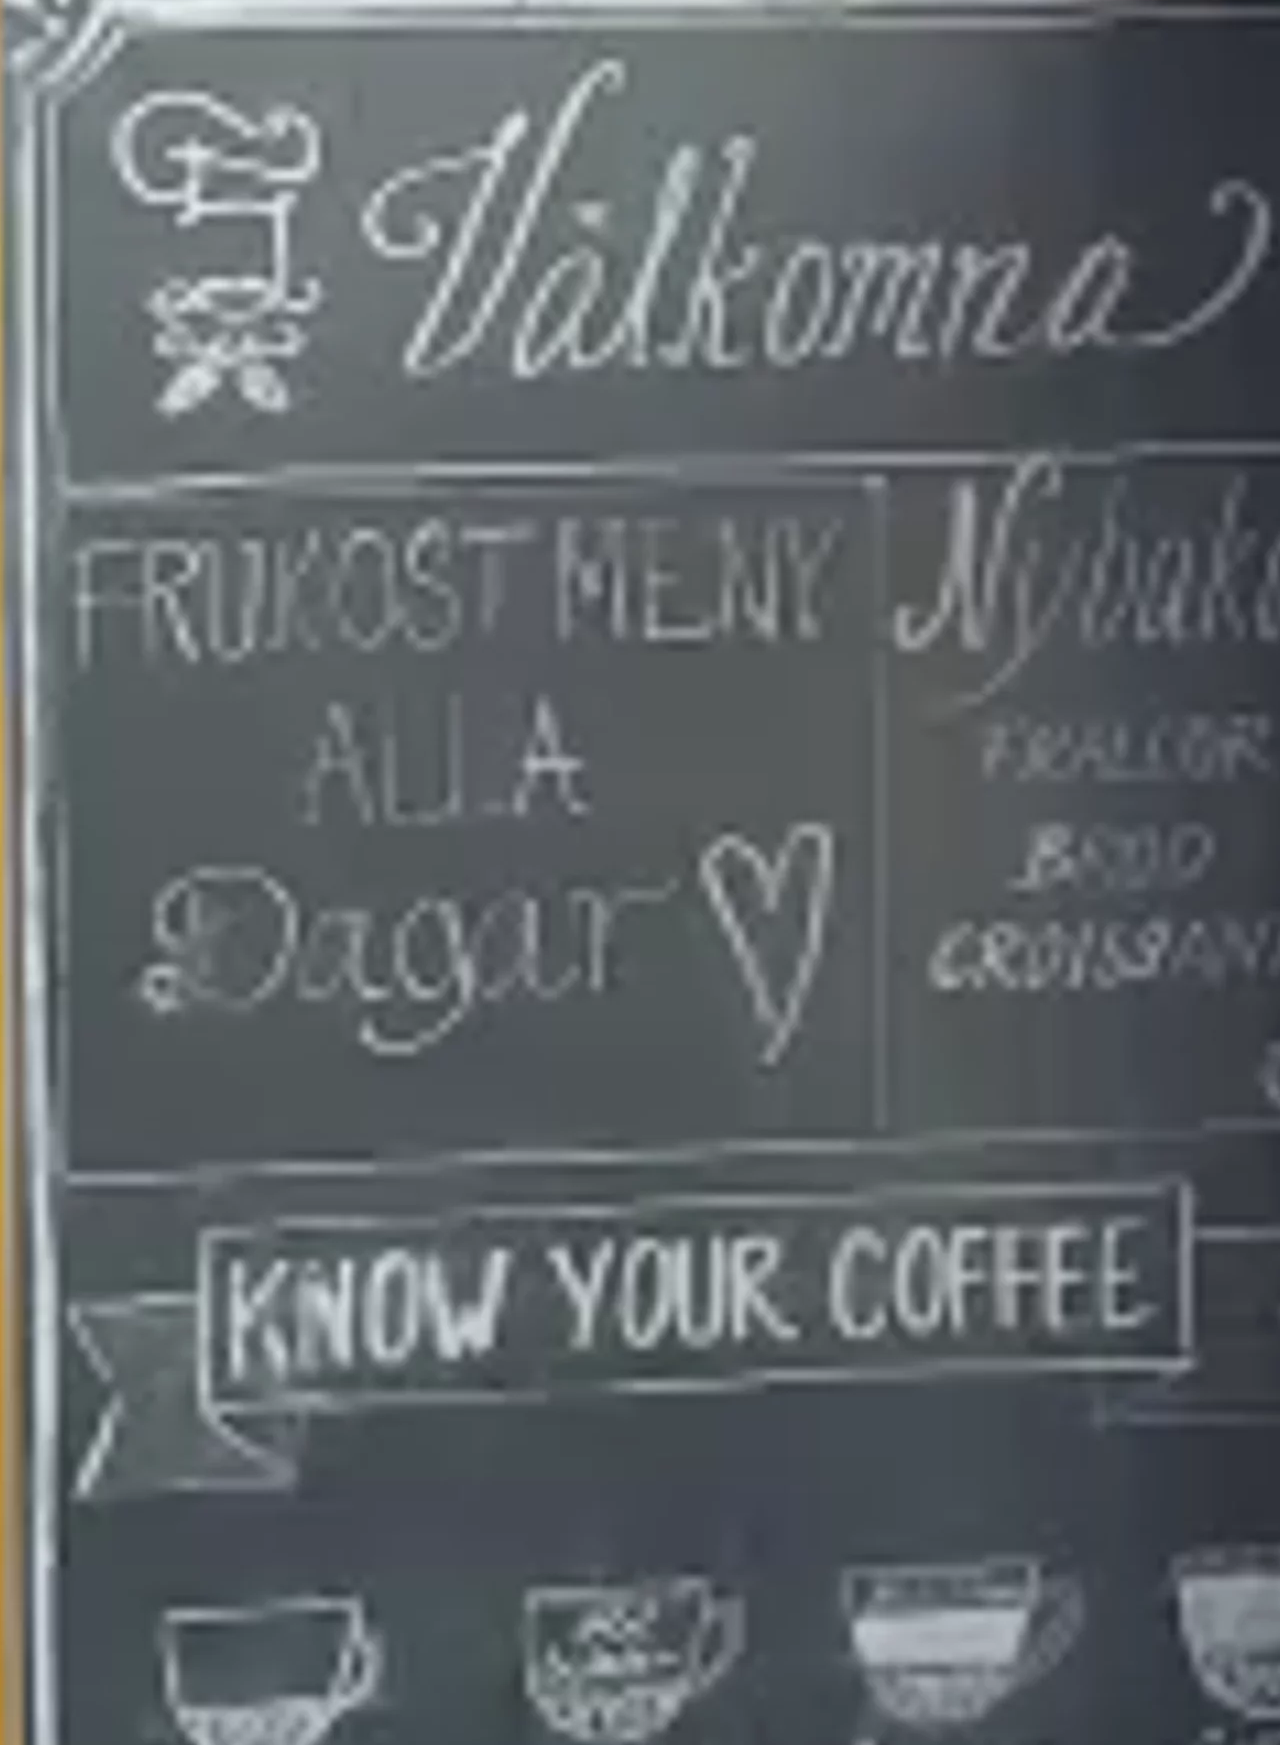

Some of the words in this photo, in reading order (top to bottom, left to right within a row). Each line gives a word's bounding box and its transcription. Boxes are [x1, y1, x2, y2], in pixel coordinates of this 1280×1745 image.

[70, 519, 538, 671] FRUKOST
[552, 515, 850, 643] MENY
[302, 689, 590, 827] ALLA
[136, 863, 682, 1055] Dagar
[222, 1247, 515, 1379] KNOW
[548, 1231, 800, 1349] YOUR
[825, 1217, 1152, 1339] COFFEE
